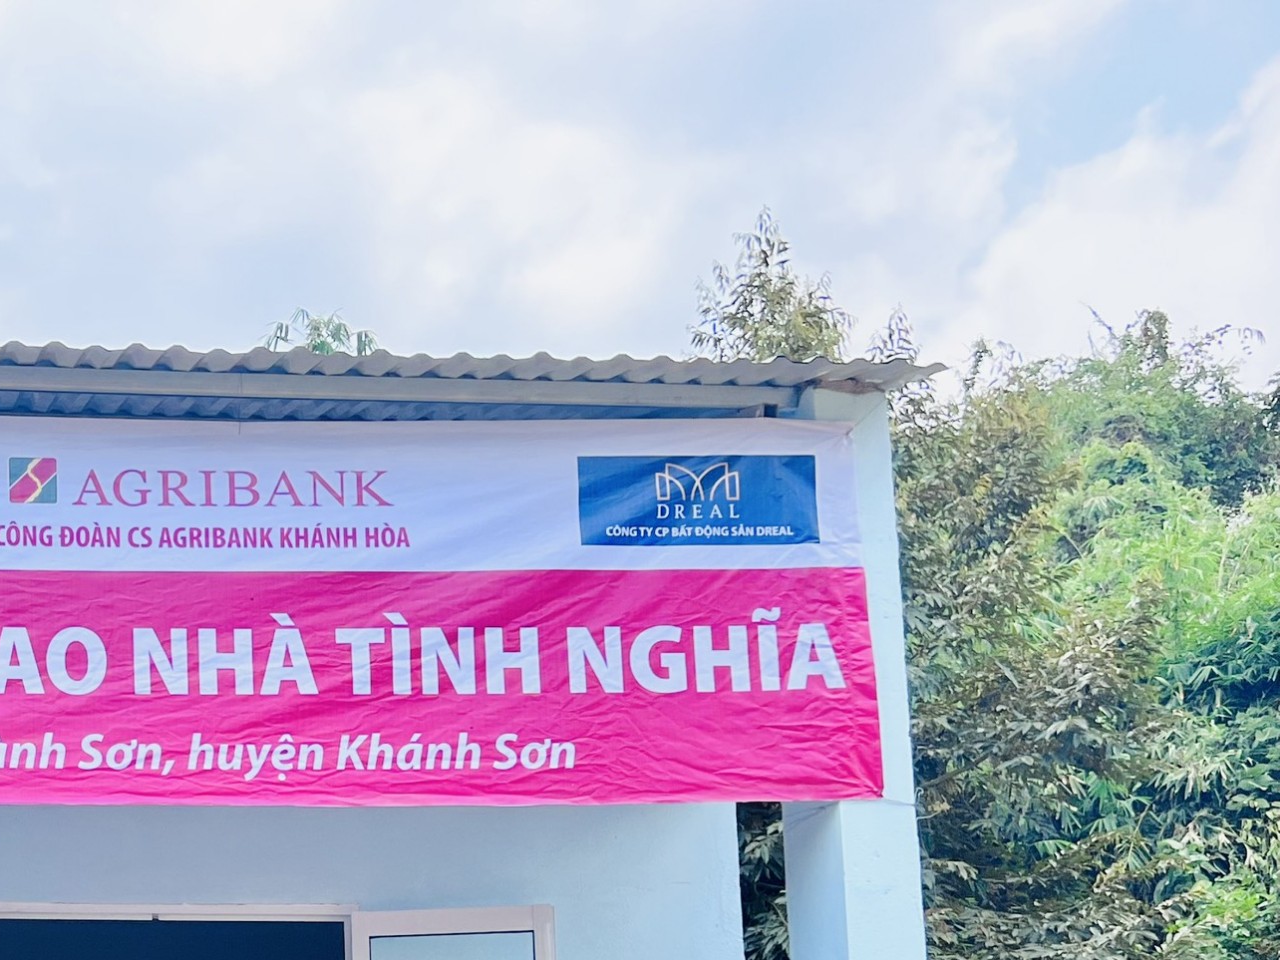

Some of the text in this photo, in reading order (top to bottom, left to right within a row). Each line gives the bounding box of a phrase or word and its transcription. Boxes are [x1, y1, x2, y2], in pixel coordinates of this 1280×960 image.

[72, 469, 395, 507] AGRIBANK
[656, 503, 740, 519] DREAL
[58, 522, 120, 548] ĐOÀN
[127, 526, 153, 548] CS
[158, 526, 274, 548] AGRIBANK
[280, 522, 358, 549] KHÁNH
[365, 522, 411, 548] HÒA
[605, 523, 794, 539] CÔNG TY CP BẤT ĐỘNG SẢN DREAL
[133, 612, 320, 695] NHÀ
[335, 612, 541, 695] TÌNH
[567, 607, 847, 694] NGHĨA
[78, 732, 173, 777] Sơn,
[188, 732, 323, 782] huyện
[335, 732, 482, 771] Khánh
[493, 733, 577, 770] Sơn
